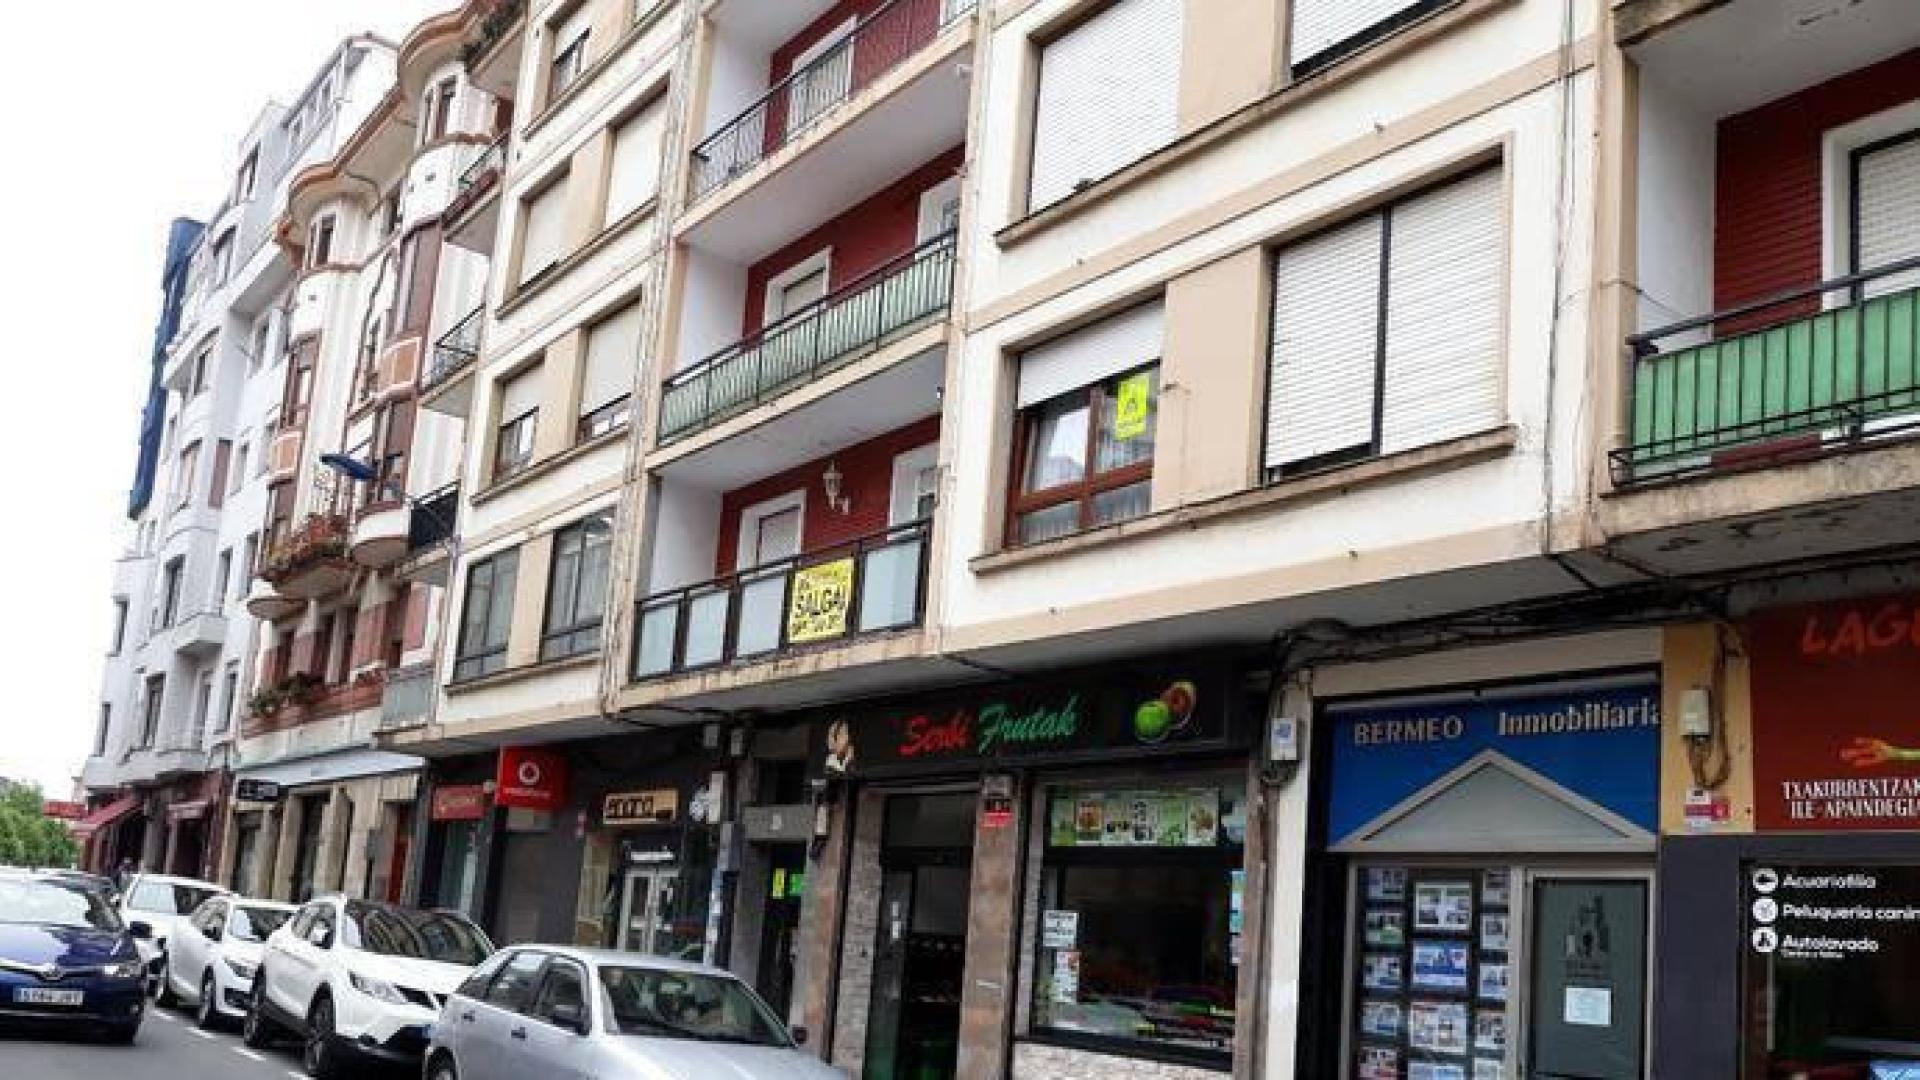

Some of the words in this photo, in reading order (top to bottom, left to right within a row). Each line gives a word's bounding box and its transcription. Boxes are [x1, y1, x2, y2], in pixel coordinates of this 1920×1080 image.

[978, 695, 1078, 755] Frutak
[1354, 715, 1464, 745] BERMEO
[1782, 934, 1879, 953] Autolavado
